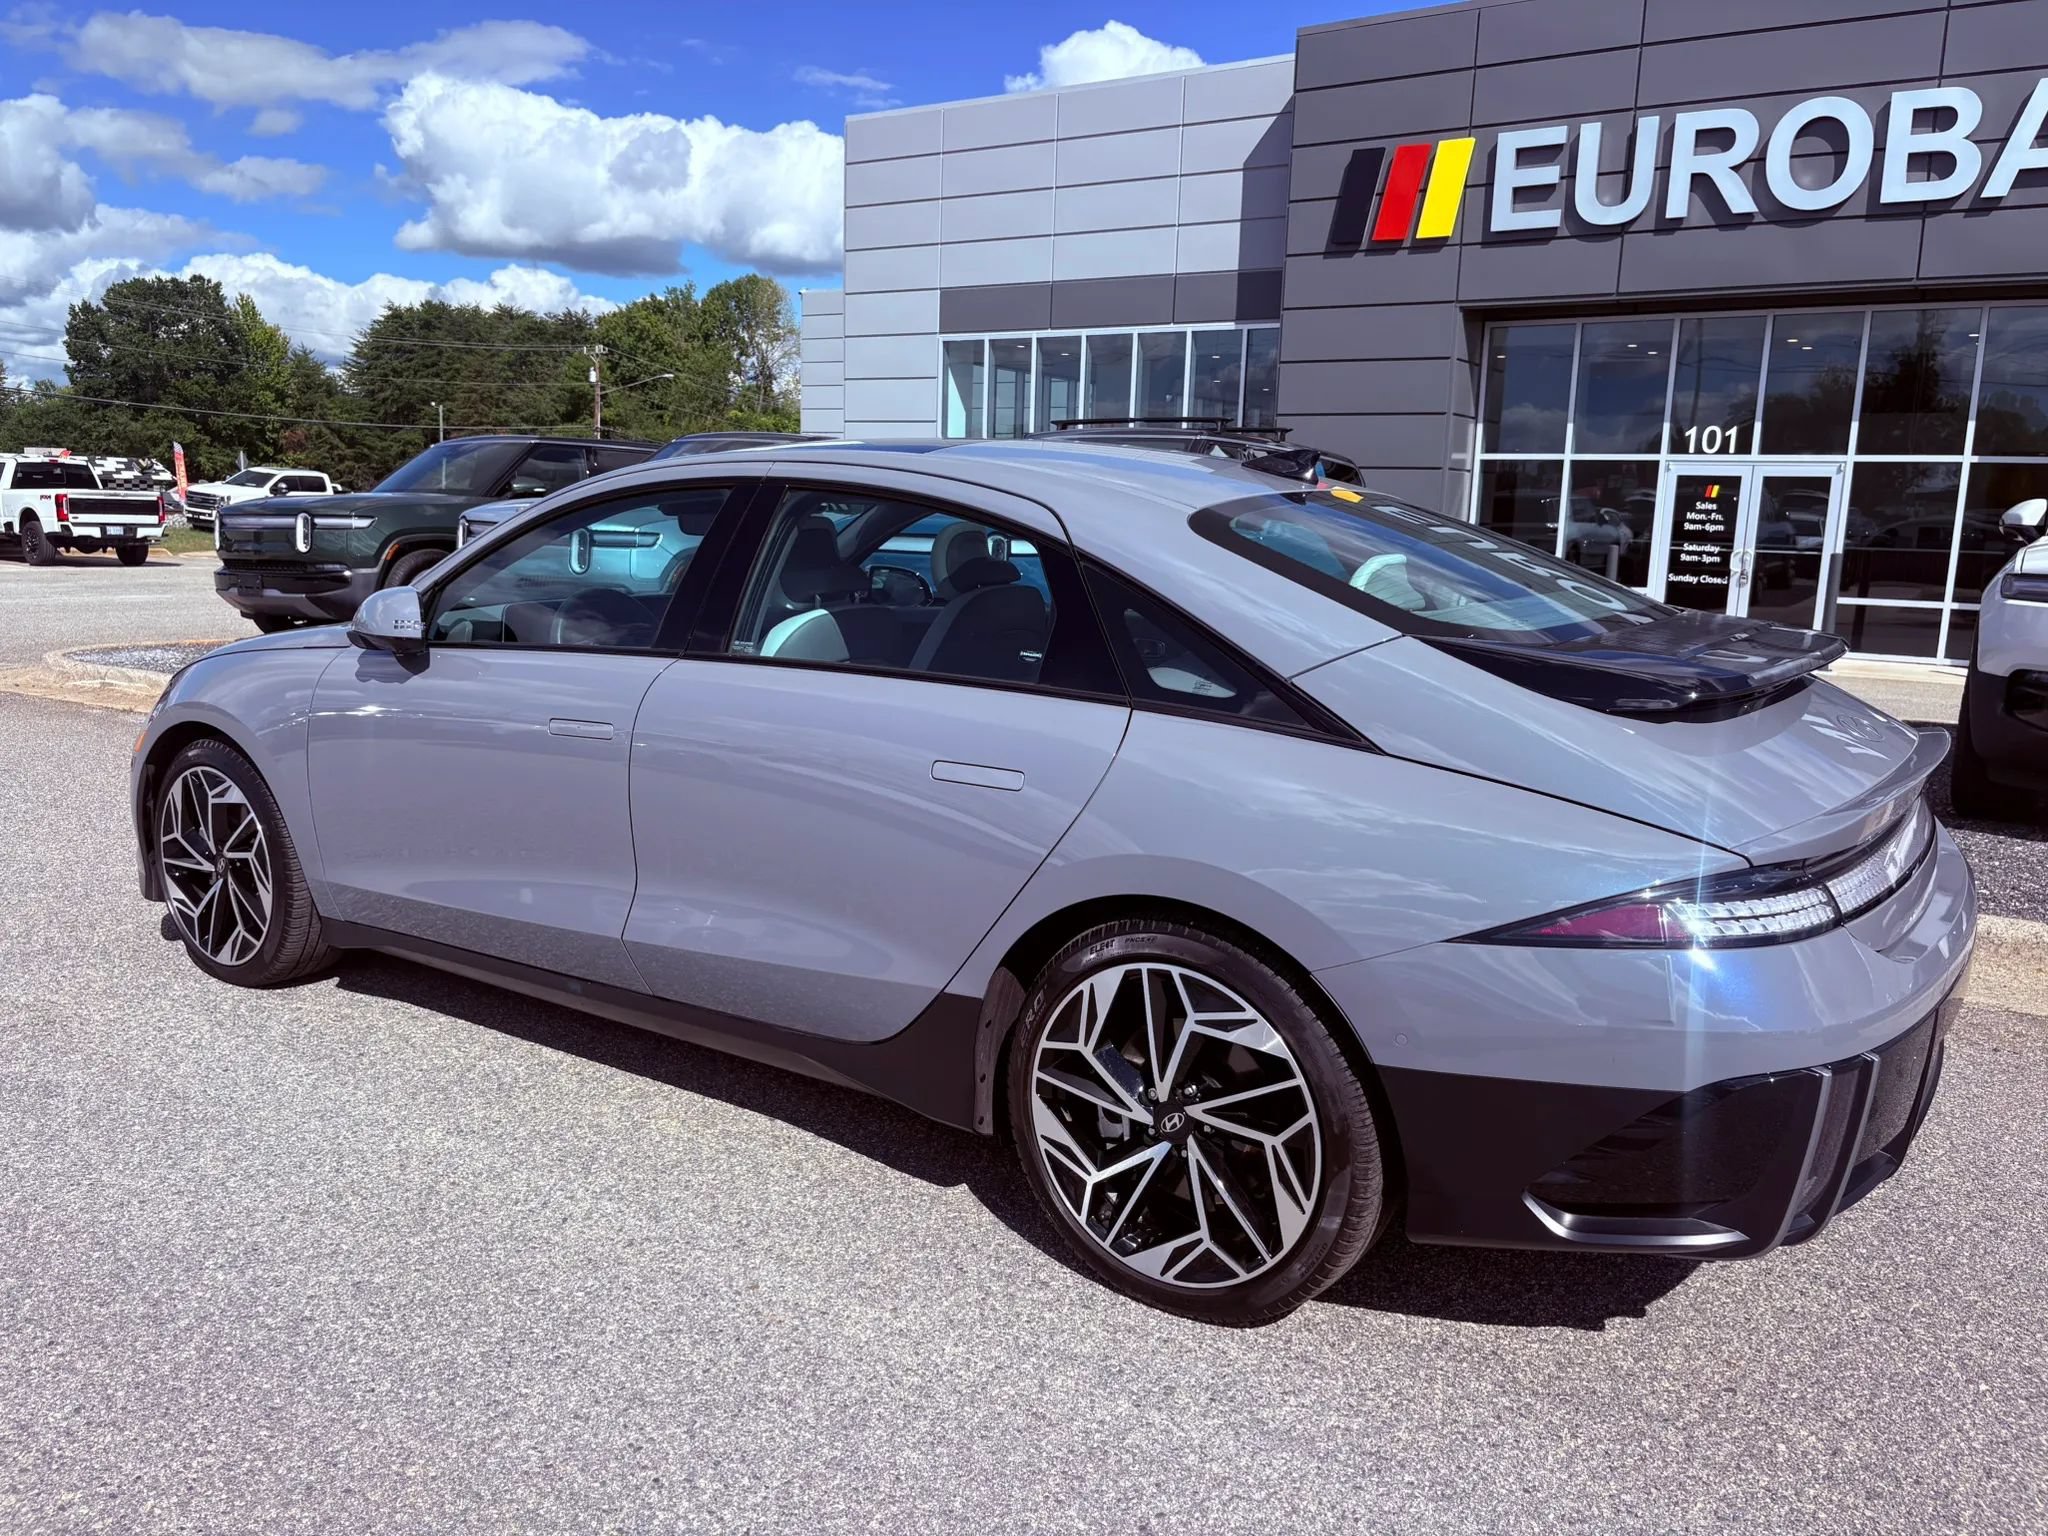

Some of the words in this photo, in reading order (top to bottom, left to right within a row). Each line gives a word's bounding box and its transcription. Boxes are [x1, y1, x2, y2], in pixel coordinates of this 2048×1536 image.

[1684, 425, 1738, 454] 101
[1695, 501, 1717, 510] Sales
[1683, 522, 1724, 533] 9am-6pm
[1683, 543, 1720, 554] Saturday
[1680, 553, 1721, 564] 9am-3pm
[1668, 573, 1698, 584] Sunday
[1700, 575, 1728, 585] Closed
